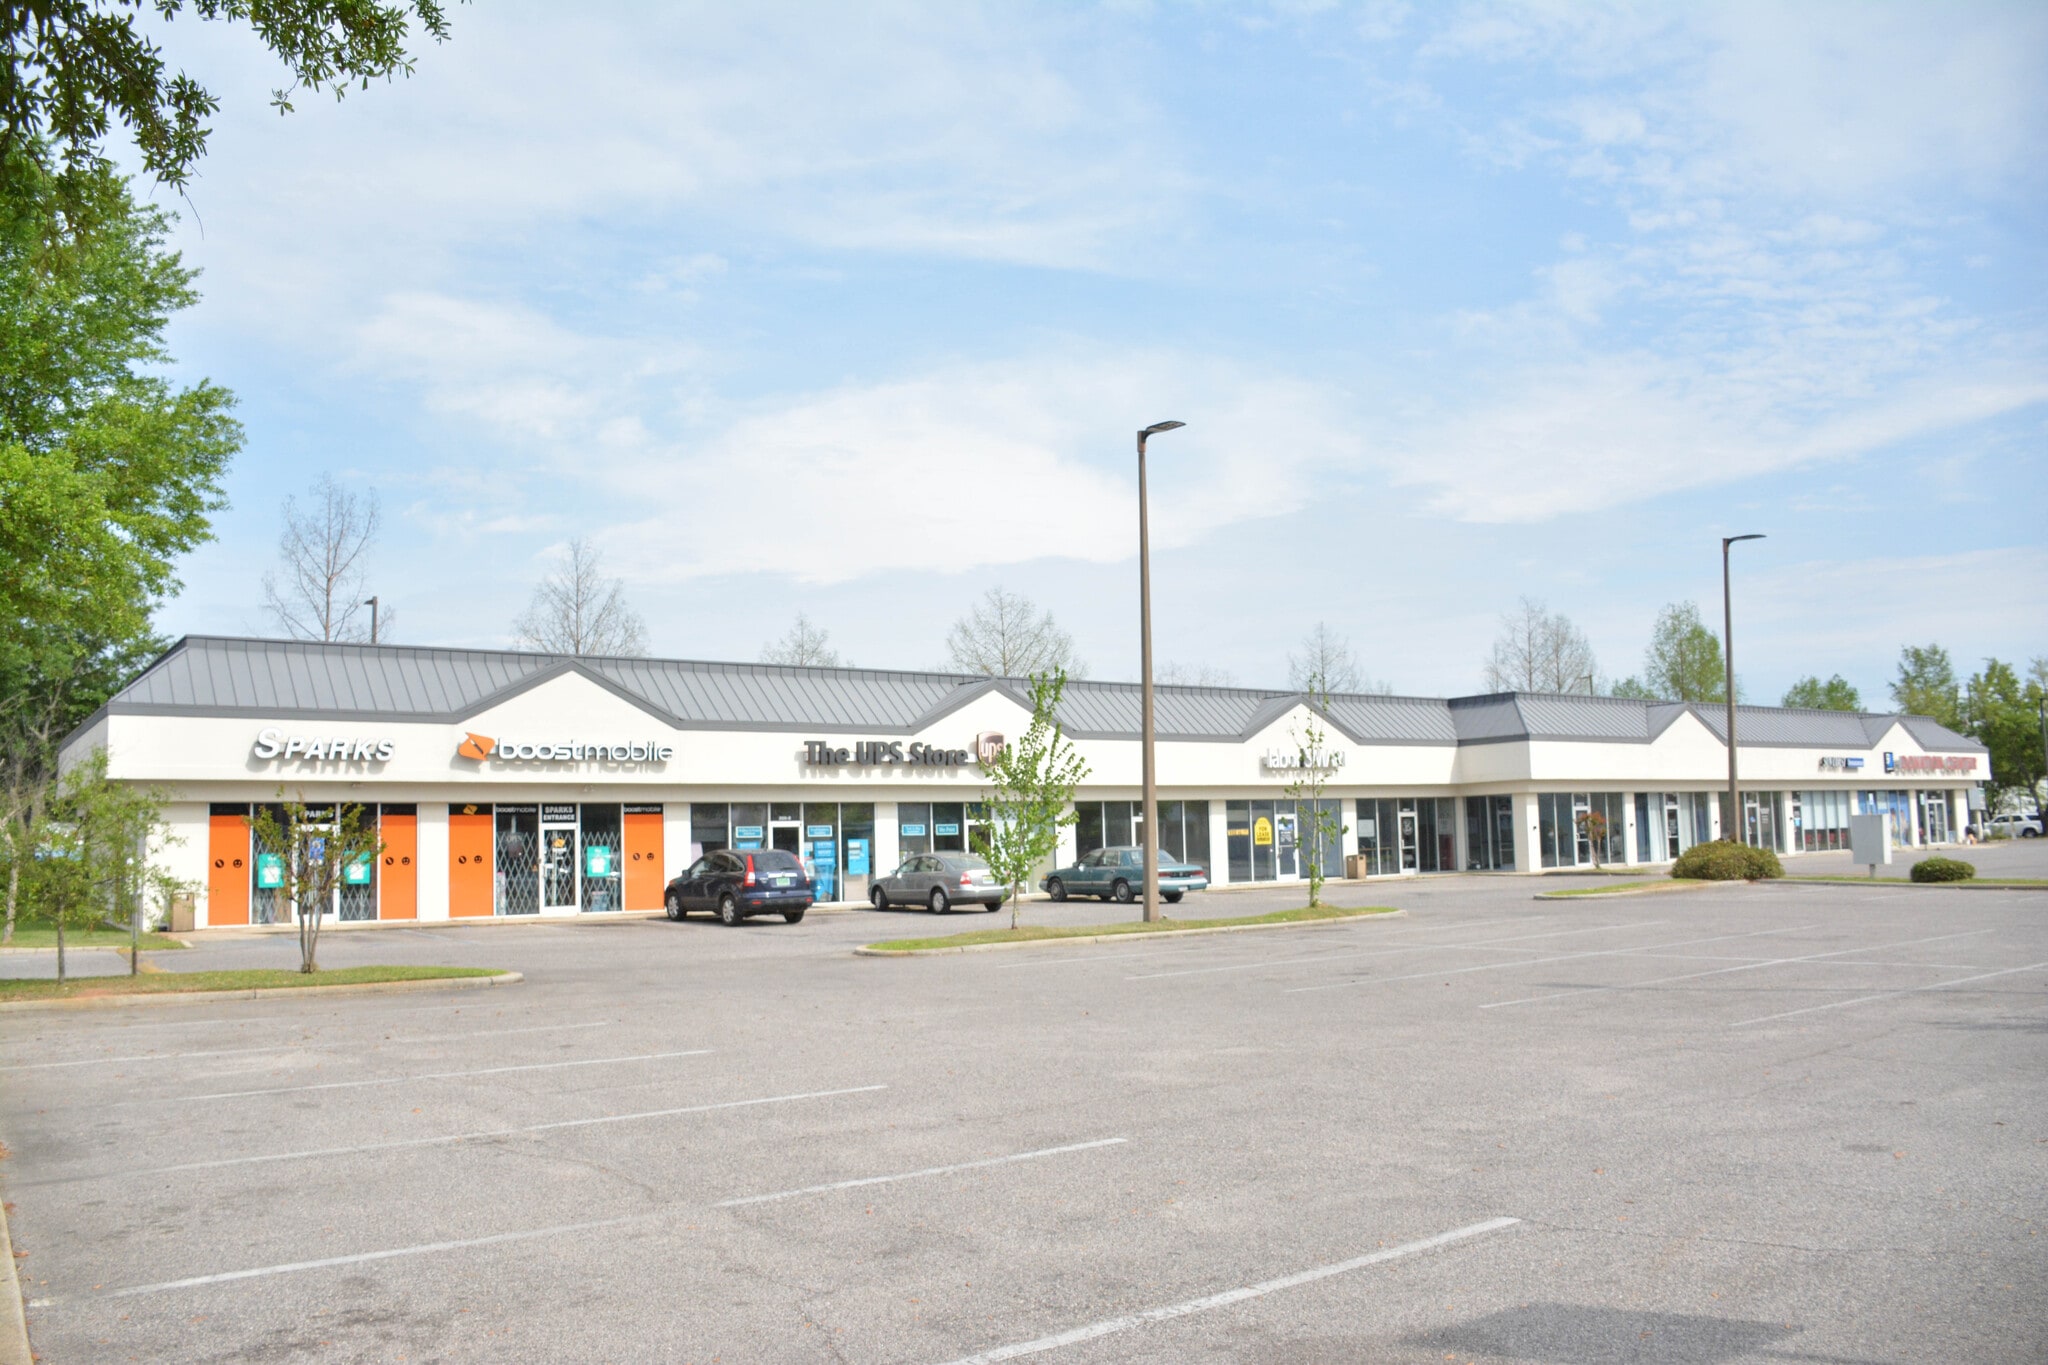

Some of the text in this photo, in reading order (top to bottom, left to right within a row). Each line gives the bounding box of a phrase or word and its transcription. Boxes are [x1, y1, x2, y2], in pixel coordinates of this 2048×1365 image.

[804, 741, 968, 766] The UPS Store
[545, 806, 573, 814] SPARKS
